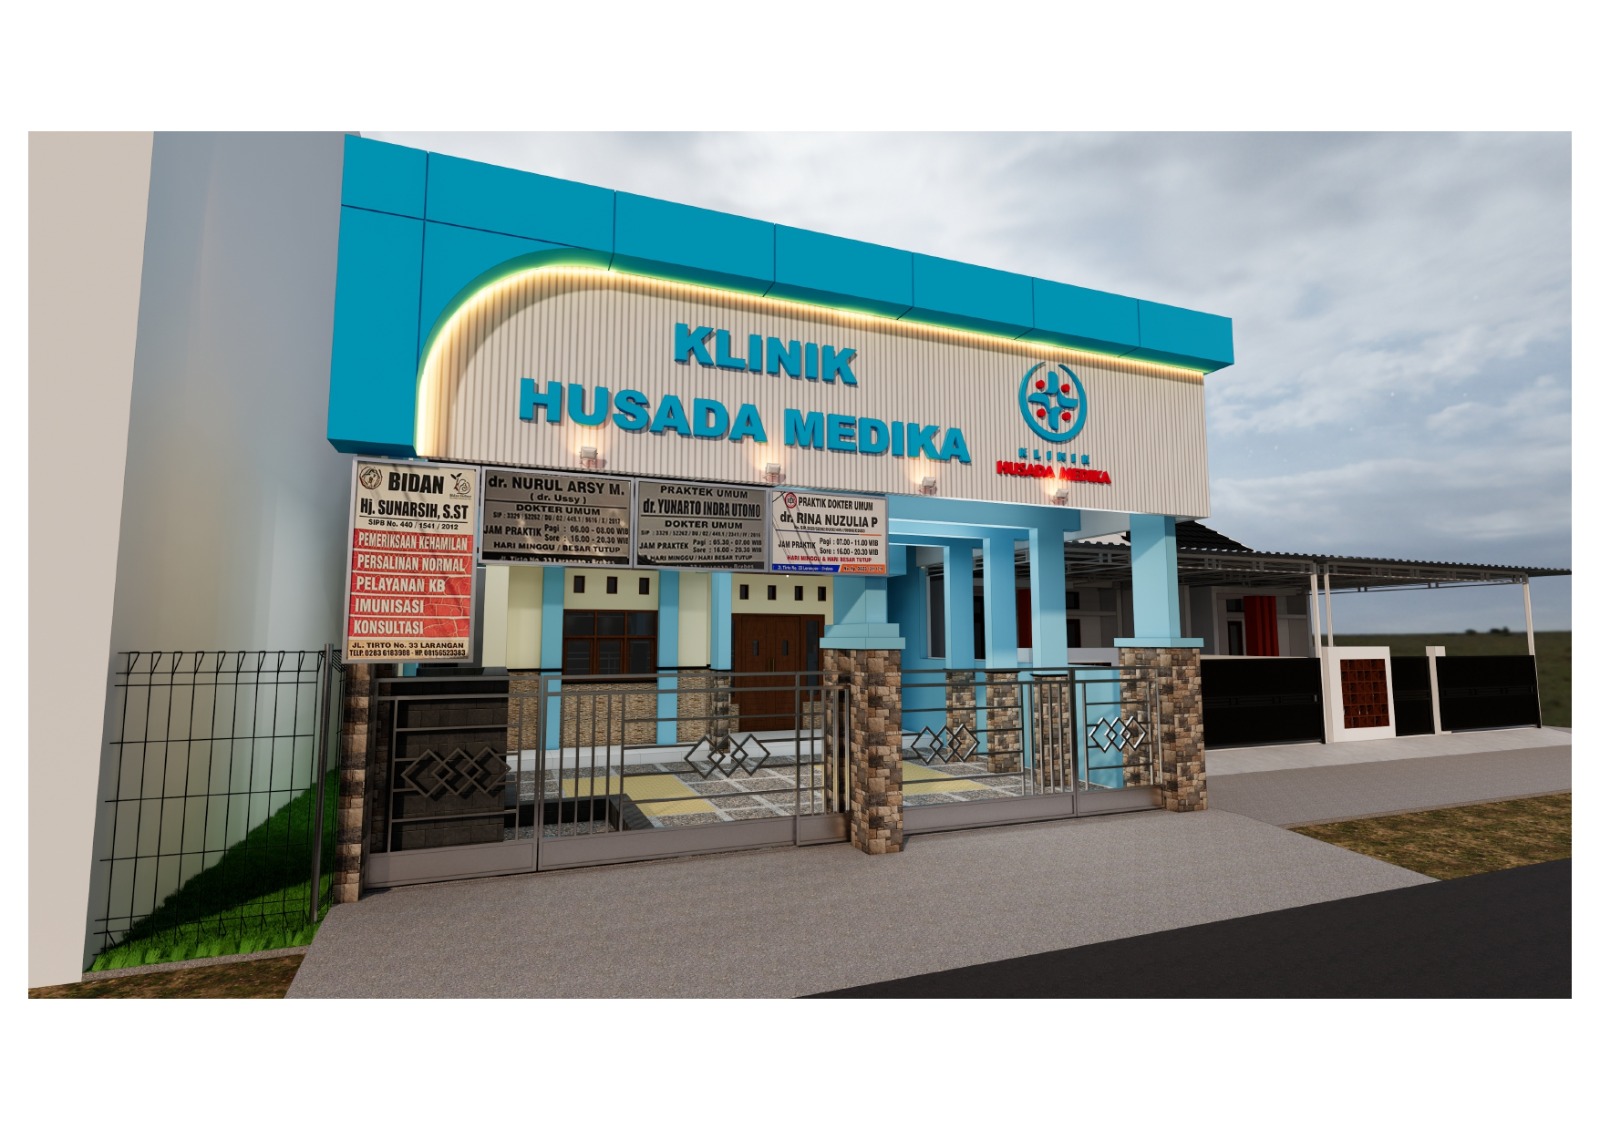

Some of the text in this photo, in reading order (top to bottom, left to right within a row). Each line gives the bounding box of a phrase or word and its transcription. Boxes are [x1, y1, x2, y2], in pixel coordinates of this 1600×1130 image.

[674, 322, 858, 386] KLINIK
[519, 377, 972, 464] HUSADA MEDIKA
[1018, 448, 1090, 466] KLINIK
[996, 460, 1111, 485] HUSADA MEDIKA
[388, 472, 445, 494] BIDAN
[488, 476, 624, 496] dr. NURUL ARSY M.
[554, 494, 580, 504] Ussy
[660, 485, 748, 498] PRAKTEK UMUM
[360, 498, 468, 520] Hj. SUNARSIH, S.ST
[516, 504, 600, 516] DOKTER UMUM
[643, 498, 760, 518] dr. YUNARTO INDRA UTOMO
[798, 496, 873, 511] PRAKTIK DOKTER UMUM
[780, 511, 878, 528] dr. RINA NUZULIA P
[484, 525, 542, 536] JAM PRAKTIK
[544, 524, 560, 533] Pagi
[358, 532, 468, 550] PEMERIKSAAN KEHAMILAN
[778, 540, 816, 549] JAM PRAKTIK
[820, 538, 831, 546] Pagi
[358, 554, 465, 572] PERSALINAN NORMAL
[356, 576, 446, 592] PELAYANAN KB
[355, 598, 424, 614] IMUNISASI
[354, 620, 424, 634] KONSULTASI
